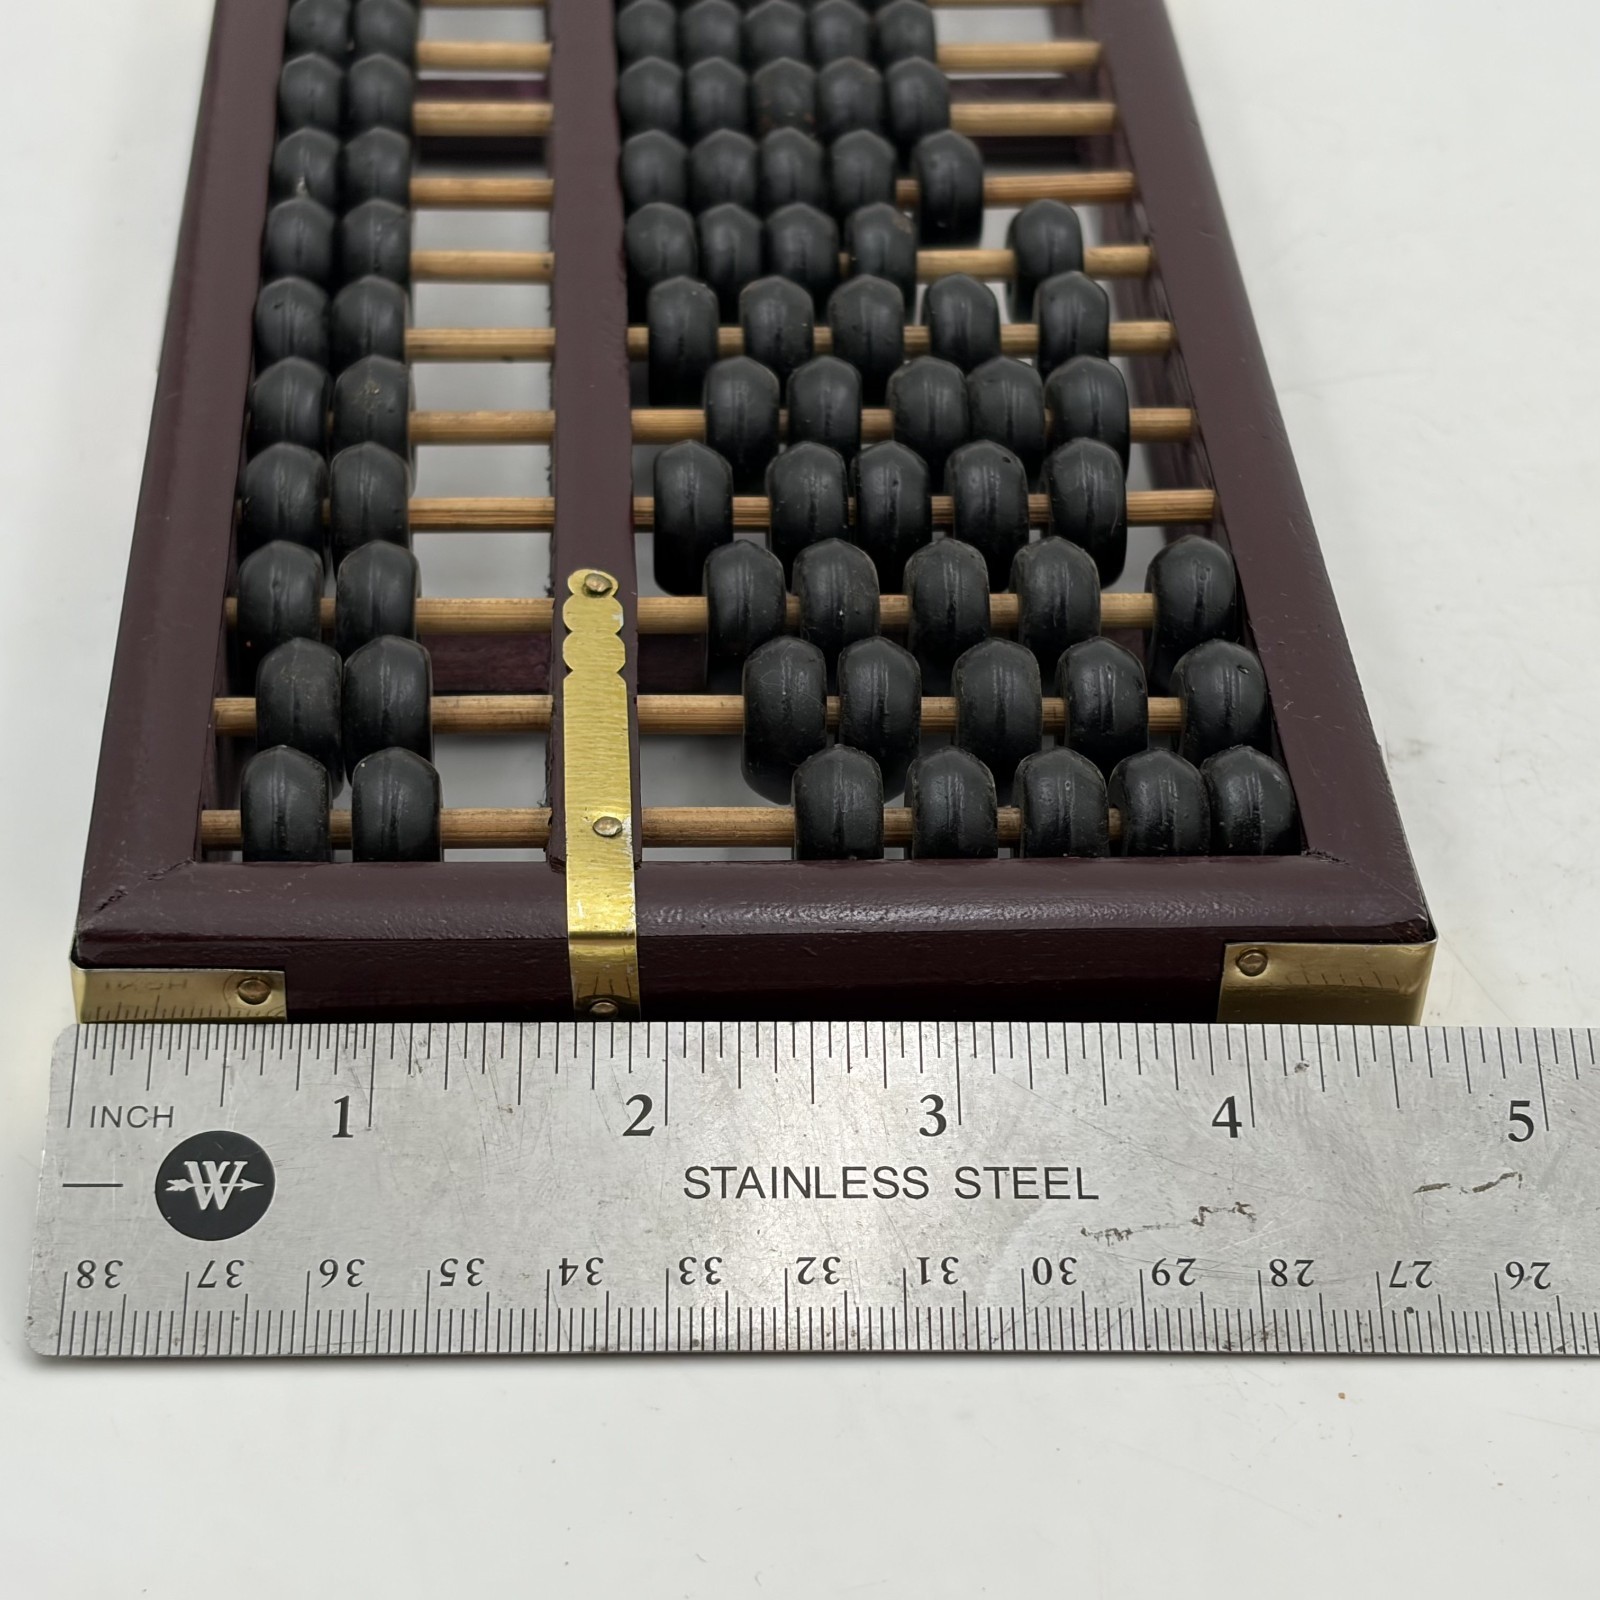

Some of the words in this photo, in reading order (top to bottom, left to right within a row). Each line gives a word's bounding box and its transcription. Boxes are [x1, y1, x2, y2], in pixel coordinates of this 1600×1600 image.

[90, 1106, 173, 1128] INCH
[332, 1096, 353, 1138] 1
[623, 1094, 655, 1136] 2
[919, 1094, 946, 1137] 3
[1212, 1096, 1242, 1138] 4
[1508, 1100, 1534, 1142] 5
[684, 1166, 929, 1200] STAINLESS
[955, 1166, 1099, 1200] STEEL
[77, 1260, 123, 1288] 38
[197, 1260, 244, 1288] 37
[320, 1259, 365, 1288] 36
[440, 1258, 484, 1286] 35
[559, 1257, 603, 1286] 34
[679, 1257, 722, 1285] 33
[796, 1257, 841, 1285] 32
[917, 1257, 959, 1285] 31
[1033, 1257, 1077, 1285] 30
[1152, 1258, 1196, 1286] 29
[1270, 1259, 1314, 1287] 28
[1389, 1261, 1432, 1288] 27
[1506, 1262, 1551, 1290] 26
